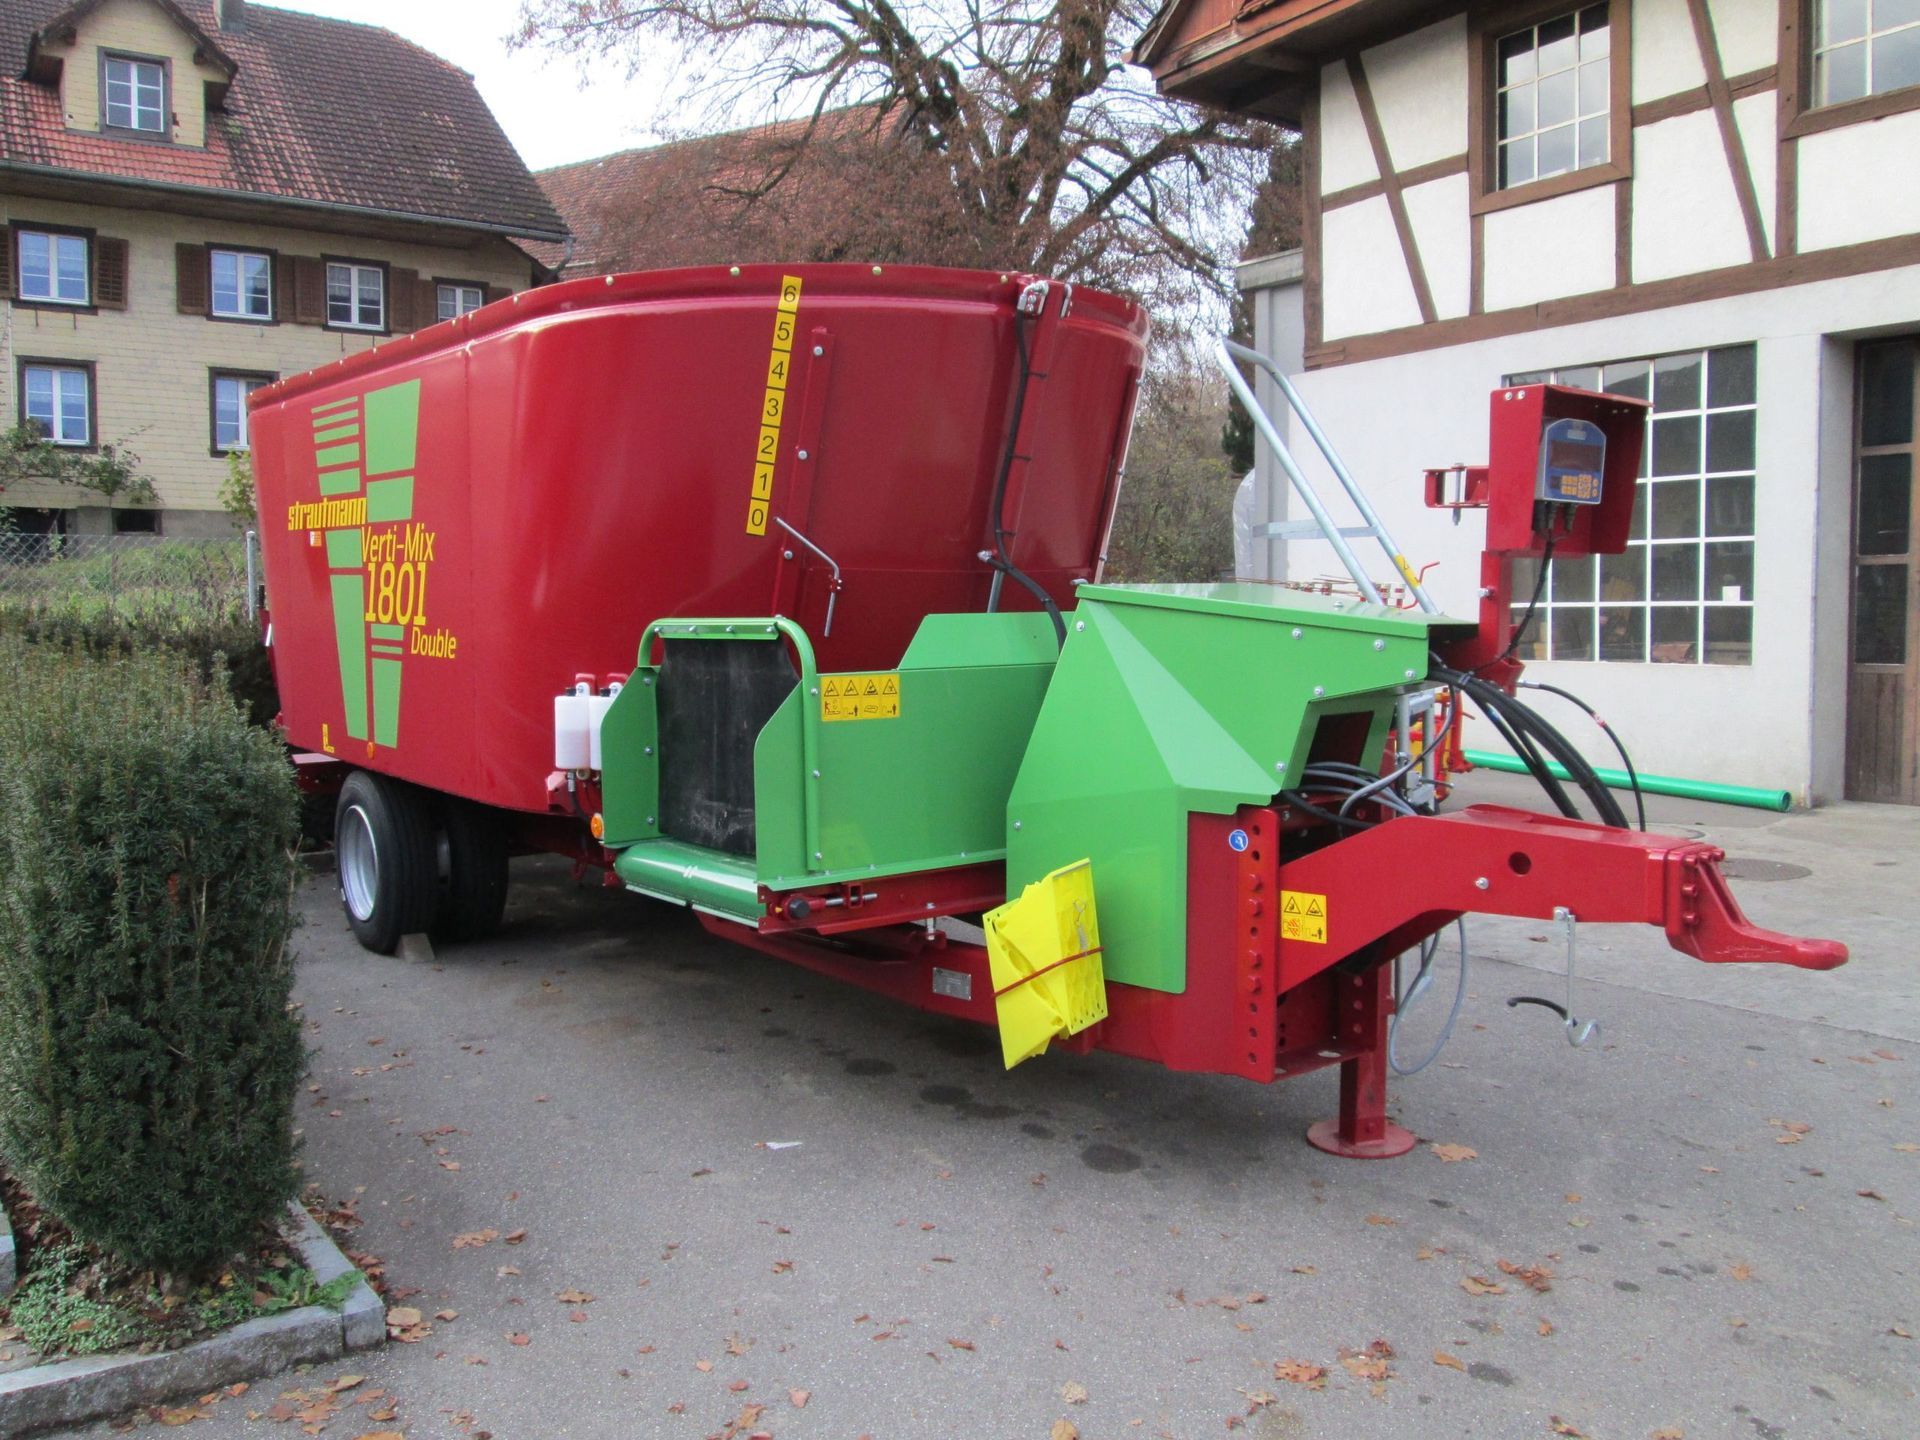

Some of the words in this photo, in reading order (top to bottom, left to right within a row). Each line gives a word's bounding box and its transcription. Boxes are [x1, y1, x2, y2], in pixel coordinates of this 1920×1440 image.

[783, 284, 797, 303] 6
[777, 321, 791, 341] 5
[771, 361, 784, 379] 4
[766, 398, 779, 417] 3
[760, 435, 775, 455] 2
[759, 472, 769, 491] 1
[288, 497, 367, 531] strautmann
[751, 508, 764, 527] 0
[361, 522, 436, 562] Verti-Mix
[365, 561, 427, 626] 1801
[411, 626, 457, 659] Double
